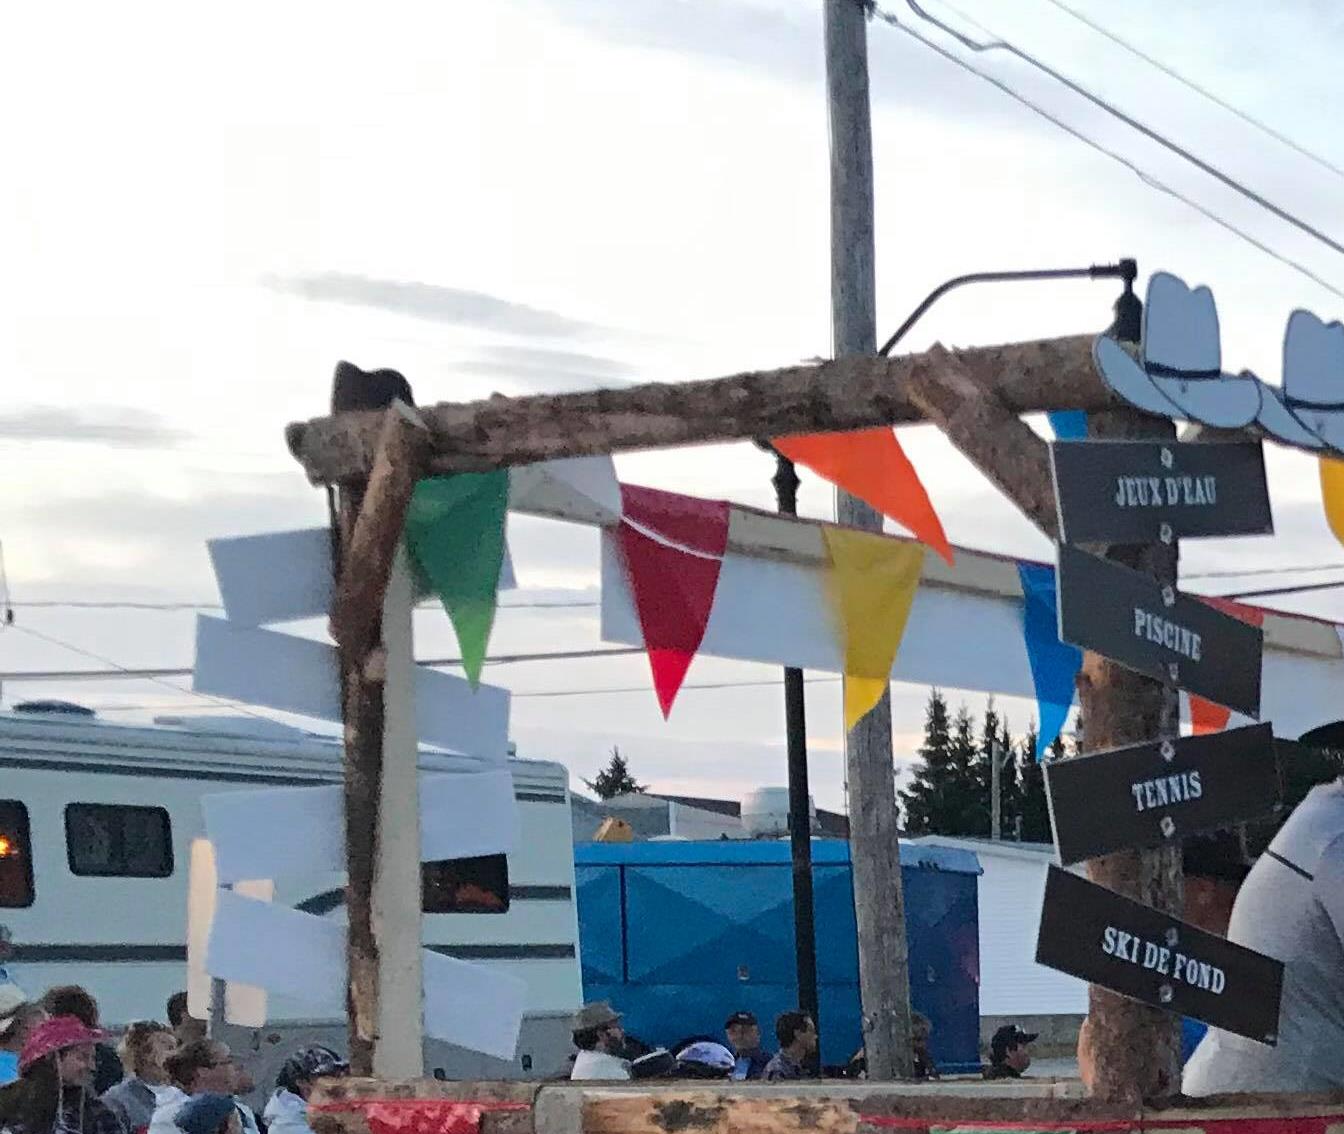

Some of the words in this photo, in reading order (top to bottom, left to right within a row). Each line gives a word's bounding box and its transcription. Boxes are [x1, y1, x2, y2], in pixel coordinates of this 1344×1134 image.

[1115, 476, 1162, 507] JEUX
[1167, 476, 1217, 505] D'EAU
[1134, 608, 1202, 662] PISCINE
[1131, 770, 1202, 812] TENNIS
[1102, 925, 1140, 965] SKI
[1144, 940, 1169, 975] DE
[1173, 952, 1226, 995] FOND
